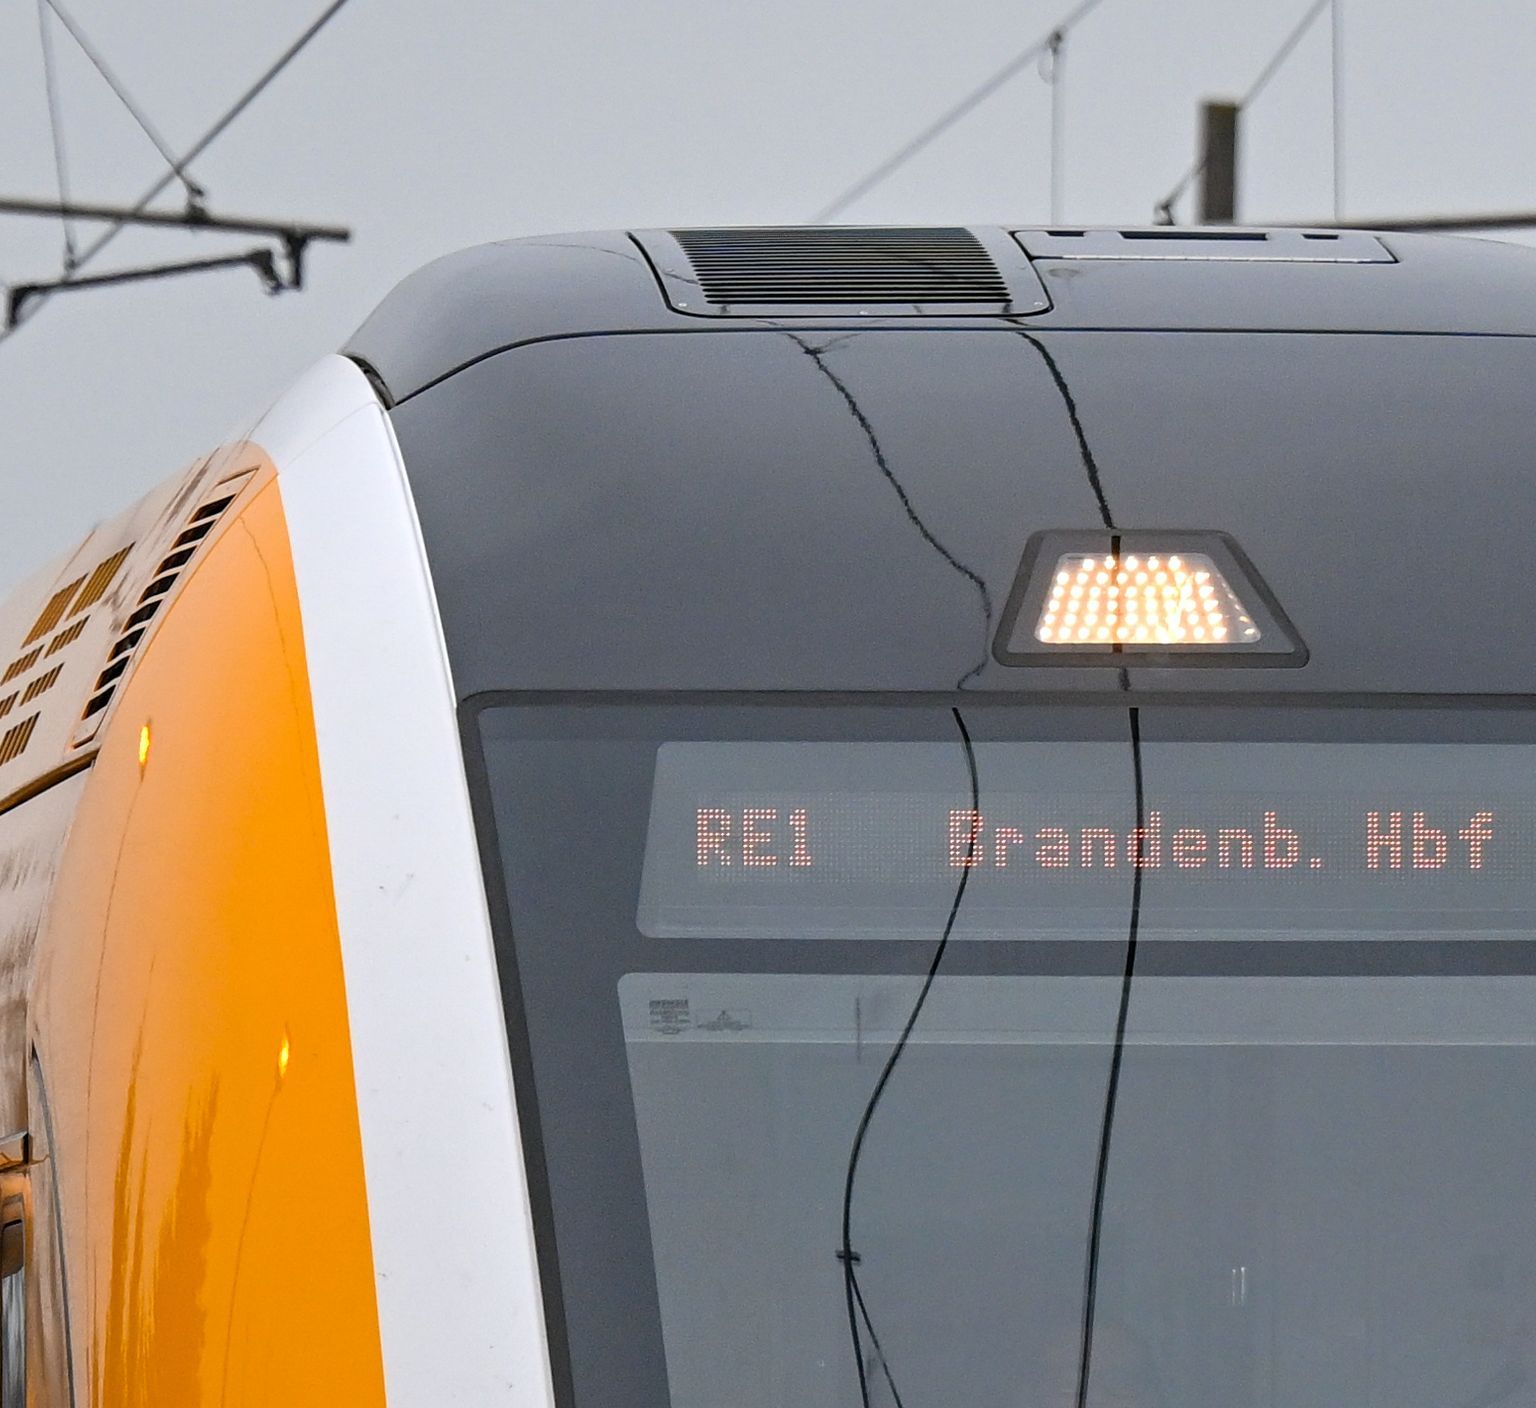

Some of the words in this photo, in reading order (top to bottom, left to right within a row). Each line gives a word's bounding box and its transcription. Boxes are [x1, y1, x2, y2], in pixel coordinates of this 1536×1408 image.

[694, 807, 813, 866] RE1
[946, 808, 1326, 870] Brandenb.
[1365, 810, 1494, 870] Hbf
